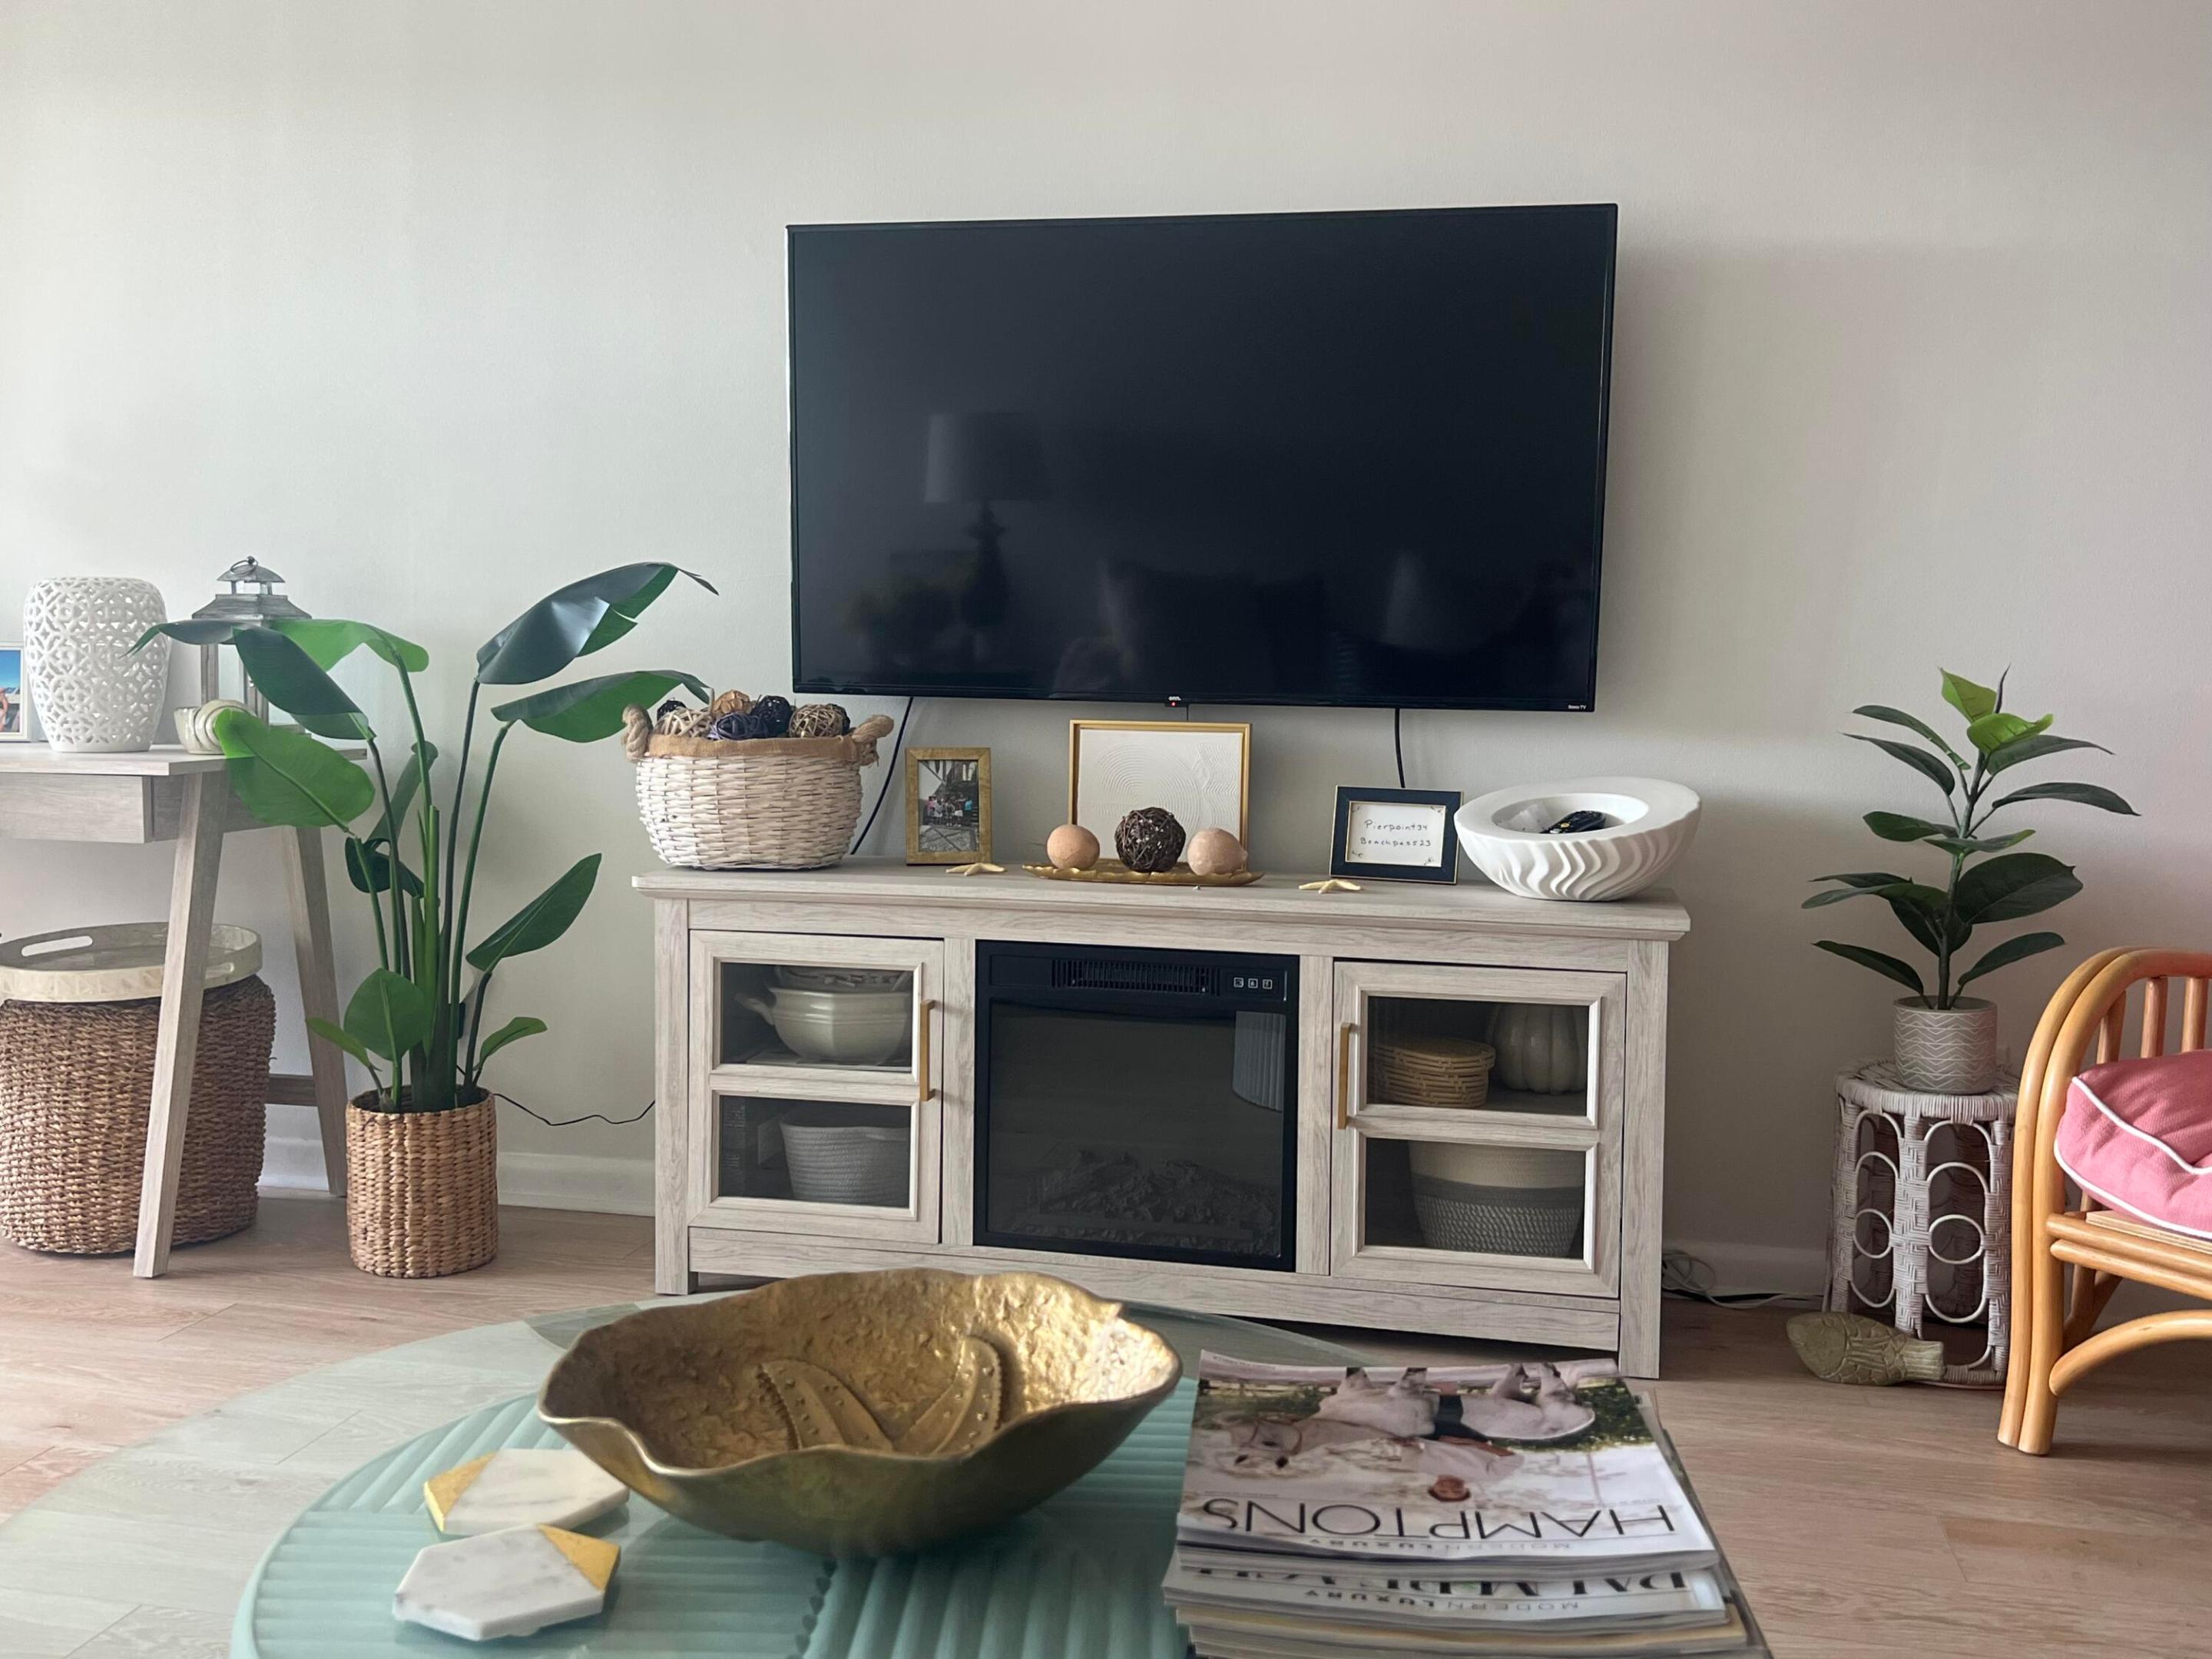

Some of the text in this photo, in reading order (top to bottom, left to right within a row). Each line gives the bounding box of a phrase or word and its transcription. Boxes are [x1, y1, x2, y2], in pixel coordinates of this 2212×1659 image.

[1202, 1497, 1675, 1539] HAMPTONS
[1310, 1538, 1571, 1550] MODERN LUXURY
[1305, 1589, 1579, 1611] MODERN LUXURY
